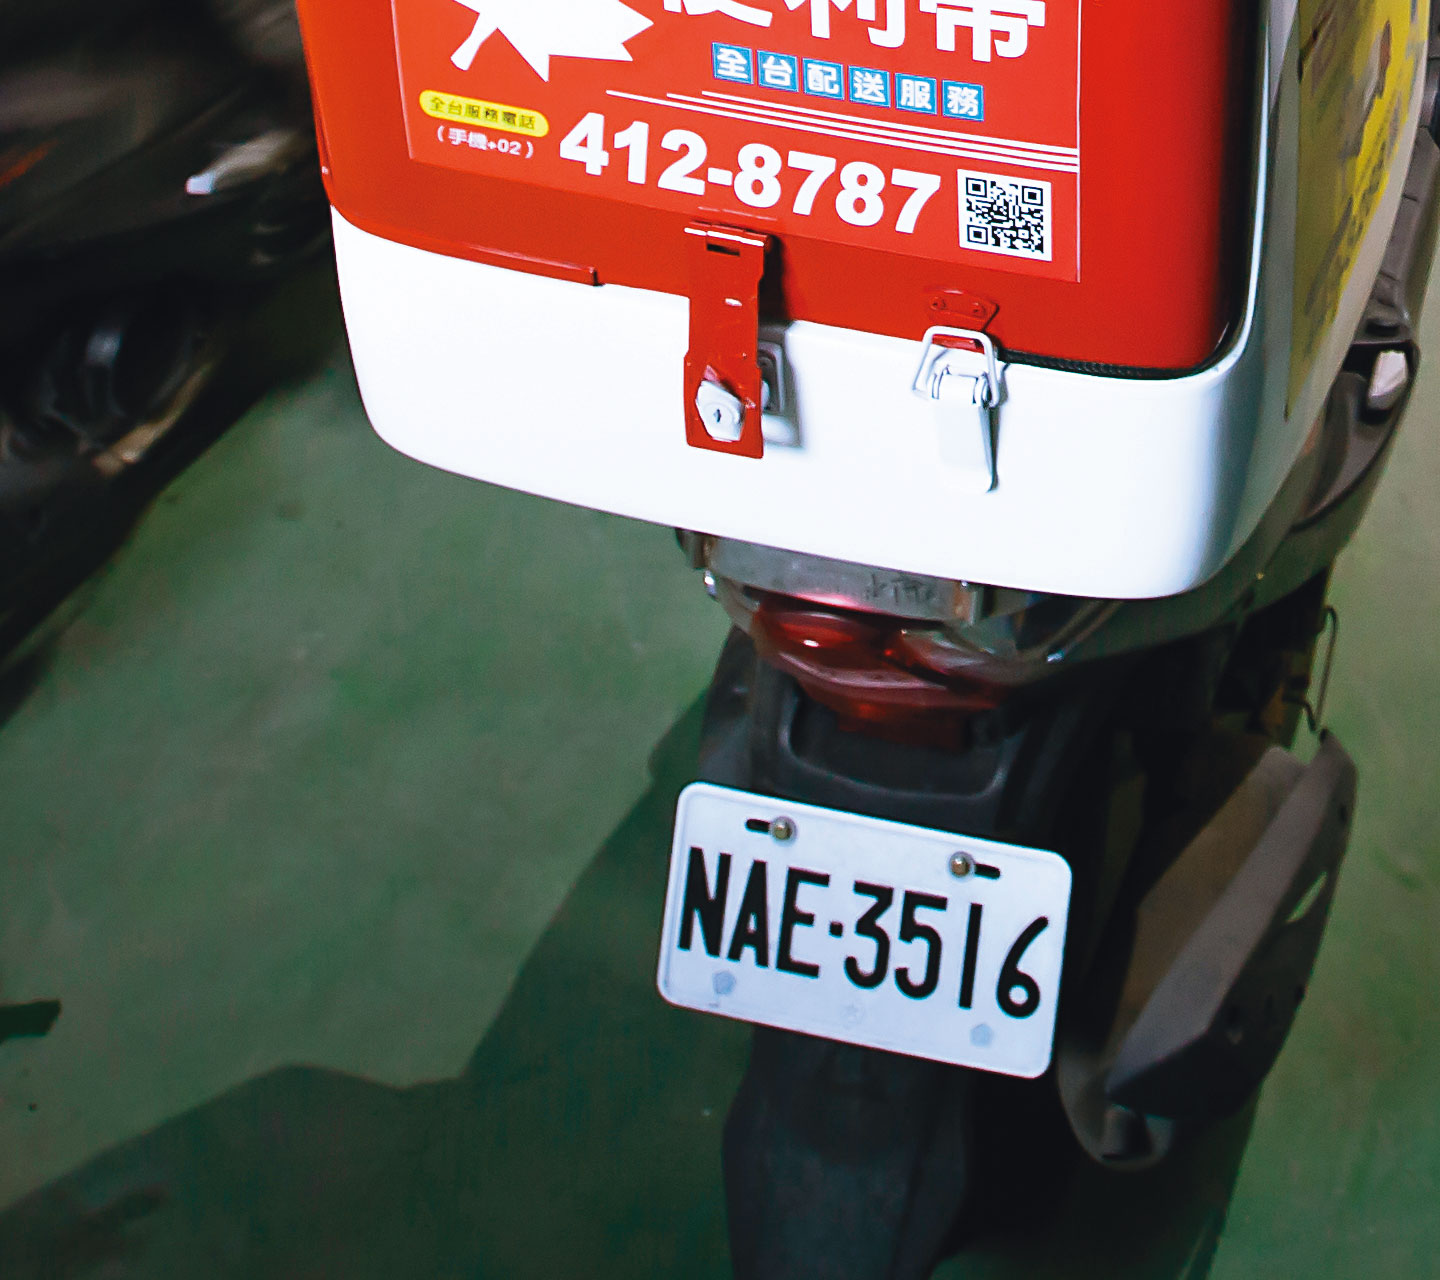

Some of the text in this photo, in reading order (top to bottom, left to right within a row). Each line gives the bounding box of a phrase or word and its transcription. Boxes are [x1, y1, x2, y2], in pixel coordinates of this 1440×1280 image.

[431, 96, 536, 130] 全台服務電話
[714, 45, 982, 120] 全台配送服務
[560, 112, 941, 234] 412-8787
[678, 846, 1050, 1019] NAE-3516
